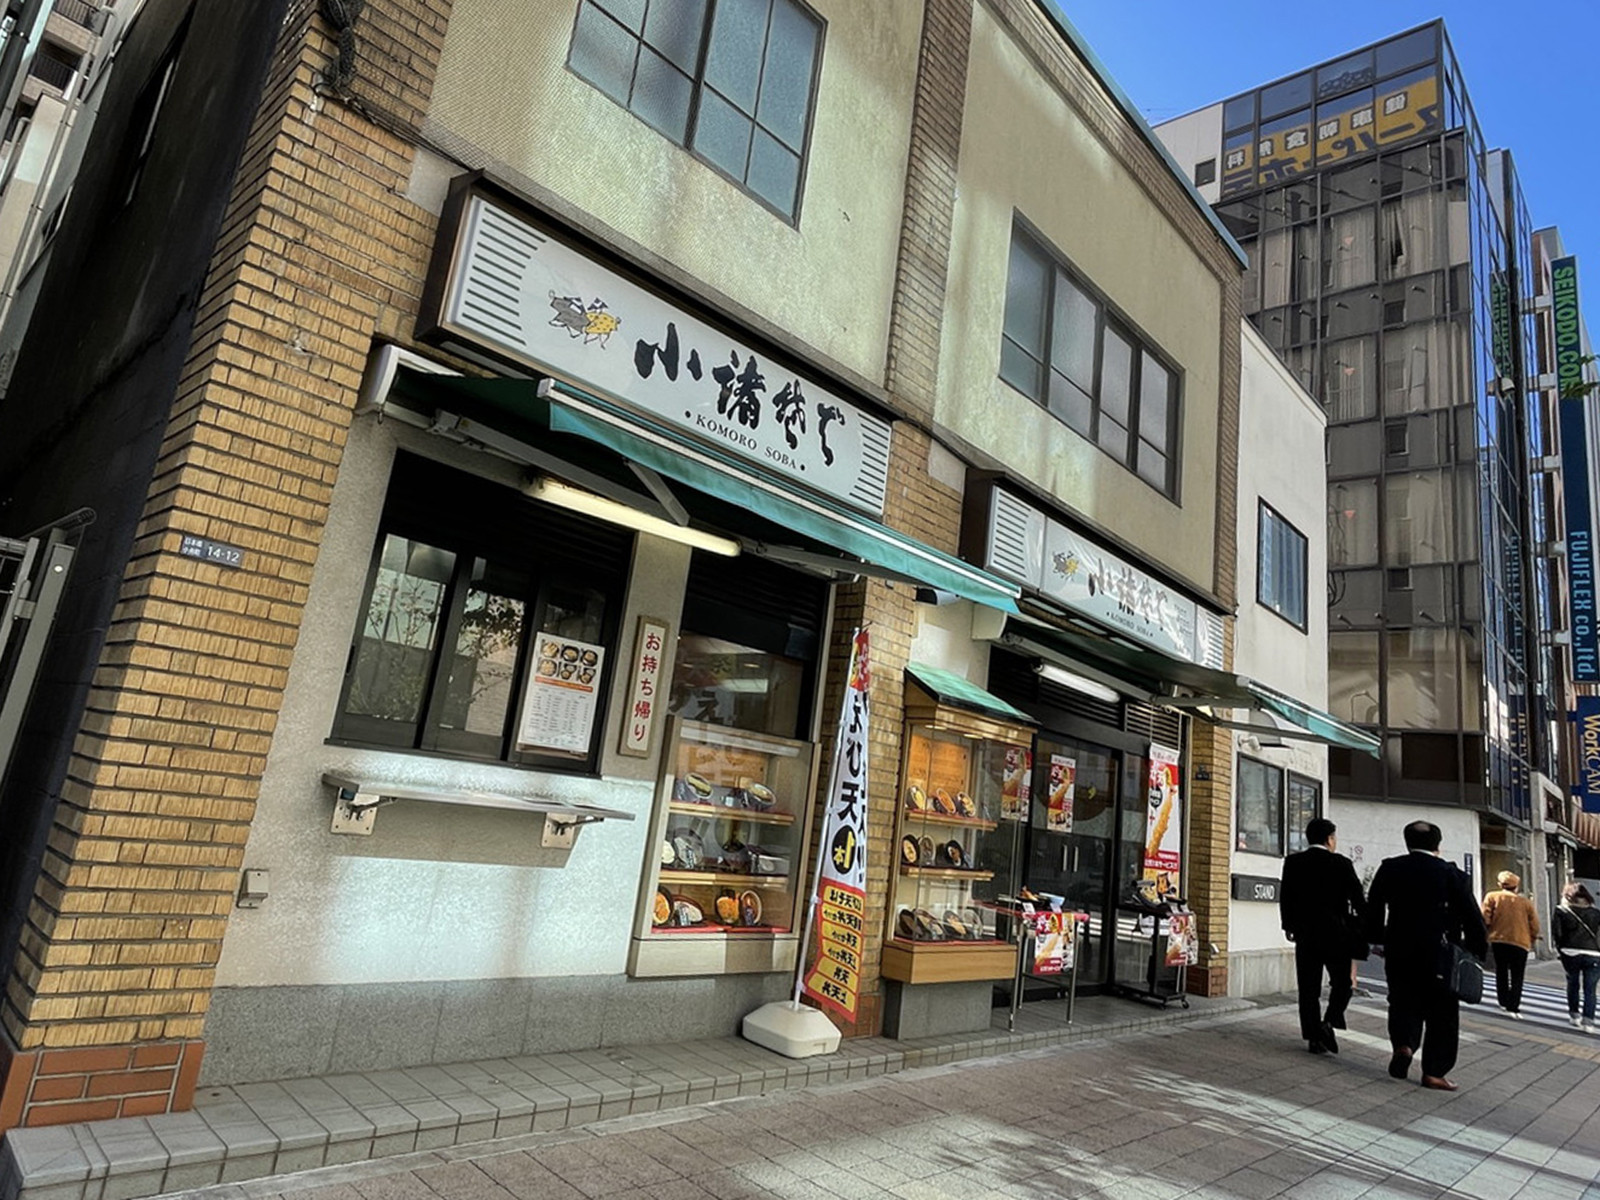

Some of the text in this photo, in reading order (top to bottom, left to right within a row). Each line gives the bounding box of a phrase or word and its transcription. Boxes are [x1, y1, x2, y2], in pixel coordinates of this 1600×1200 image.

[696, 414, 797, 470] KOMORO SOBA
[208, 546, 240, 563] 14-12
[1570, 531, 1592, 610] FUJIFLEX
[634, 632, 661, 742] お持ち帰り
